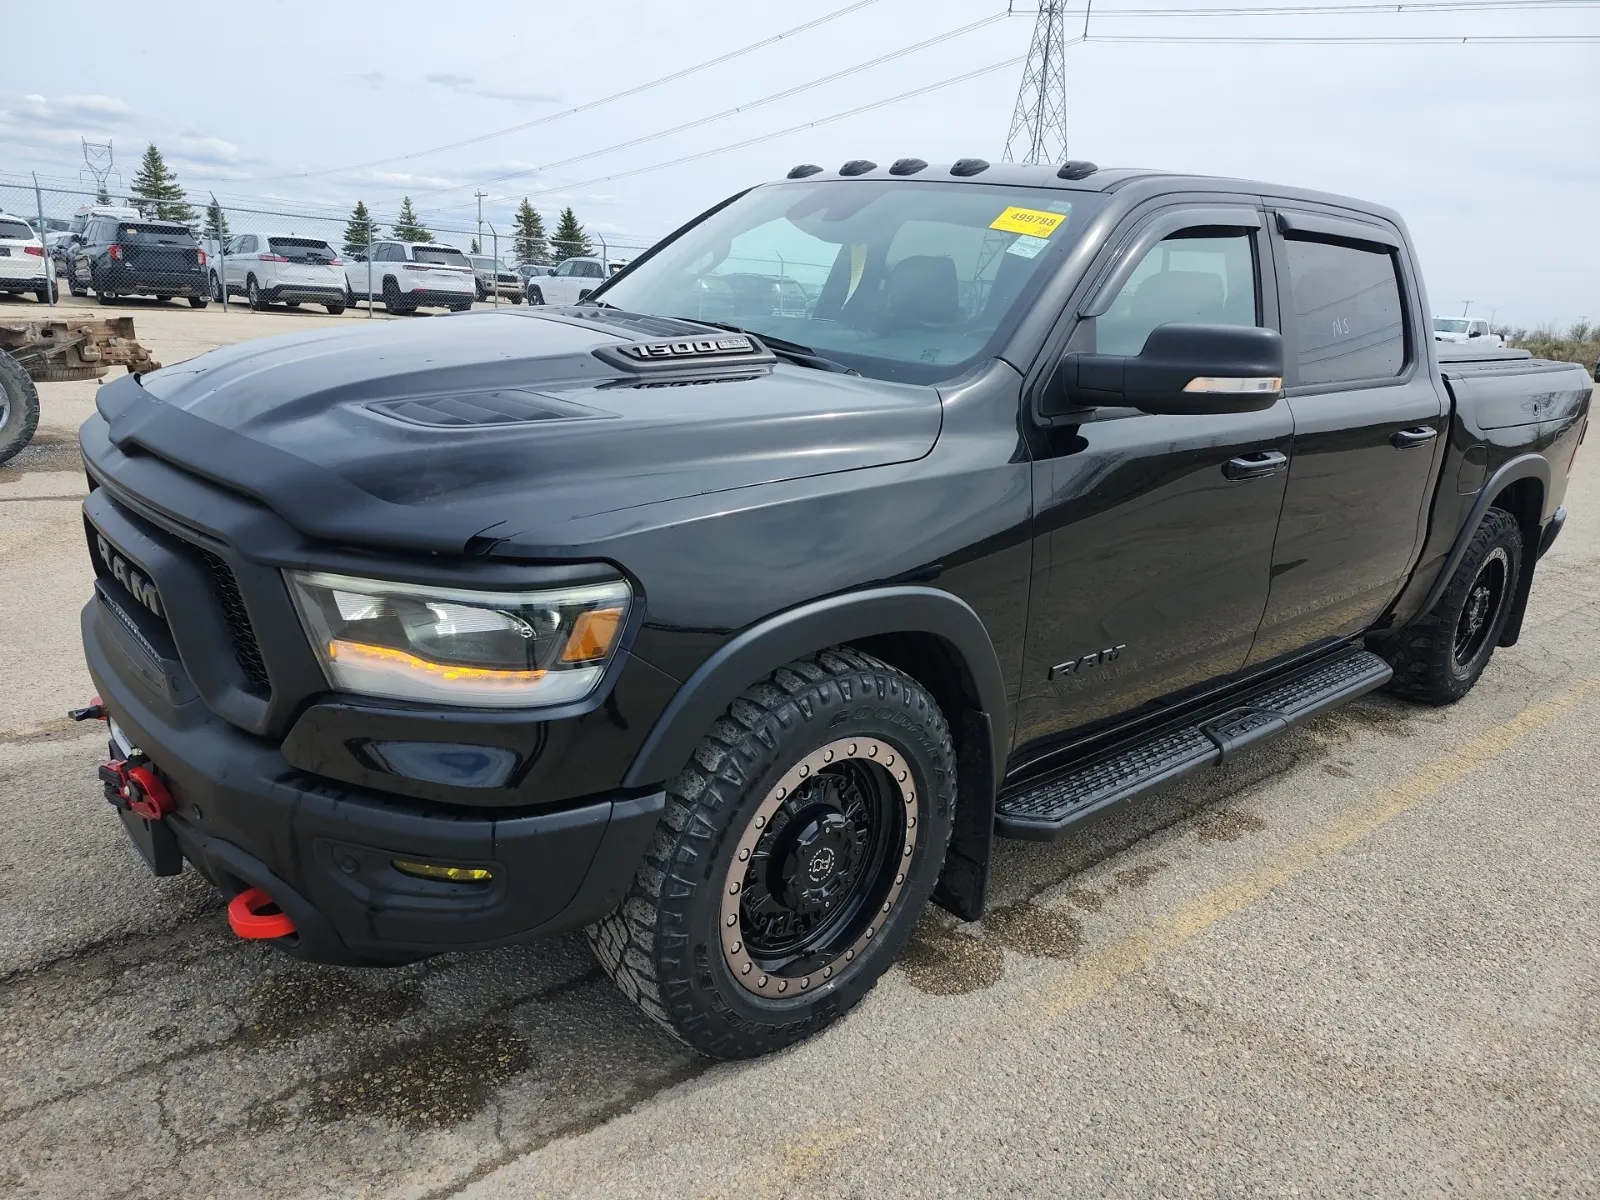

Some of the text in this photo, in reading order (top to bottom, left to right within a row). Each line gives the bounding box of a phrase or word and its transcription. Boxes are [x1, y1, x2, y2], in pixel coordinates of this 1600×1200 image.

[1010, 212, 1057, 227] 499788
[632, 340, 717, 357] 1500
[96, 533, 166, 620] RAM
[1047, 643, 1127, 681] RAM
[826, 704, 950, 818] GOODYEAR
